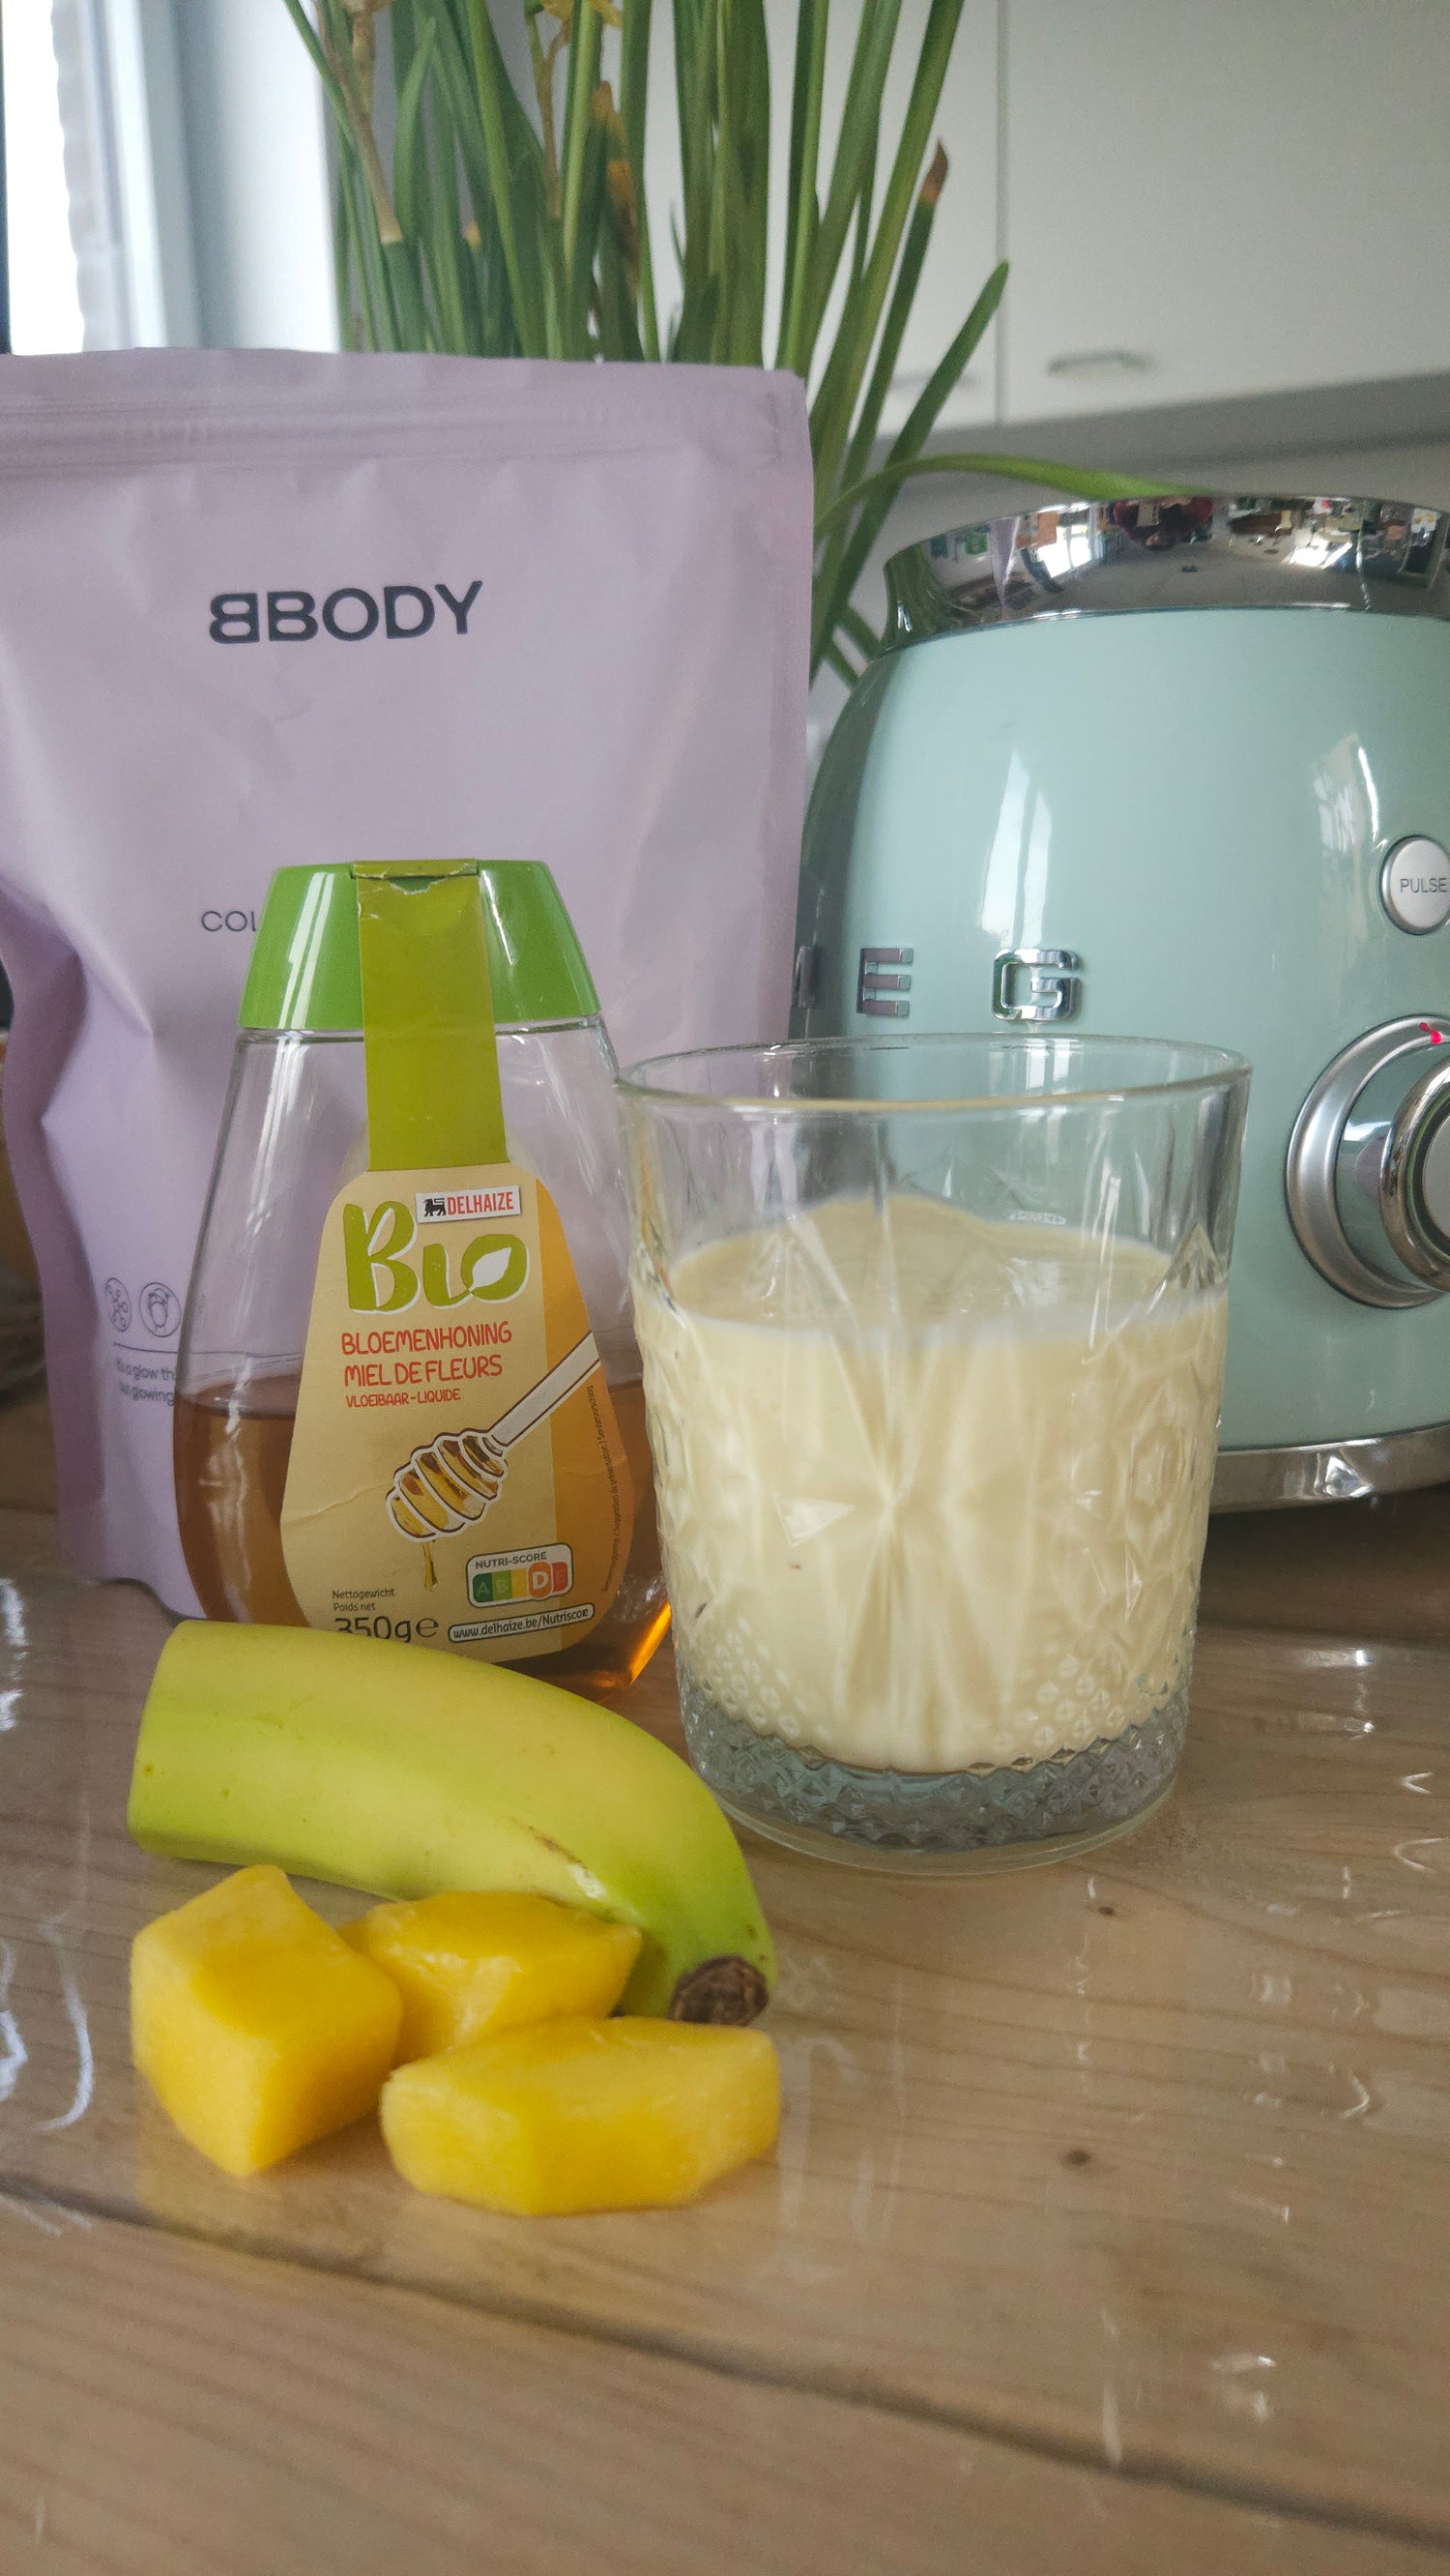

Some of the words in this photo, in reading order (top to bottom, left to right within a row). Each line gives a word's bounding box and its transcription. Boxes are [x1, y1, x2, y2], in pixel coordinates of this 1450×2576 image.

[1399, 877, 1448, 893] PULSE
[447, 1191, 514, 1216] DELHAIZE
[341, 1321, 512, 1356] BLOEMENHONING
[344, 1361, 391, 1387] MIEL
[394, 1361, 422, 1385] DE
[425, 1354, 503, 1383] FLEURS
[475, 1551, 547, 1569] NUTRI-SCORE
[532, 1570, 549, 1590] D
[332, 1588, 395, 1600] Nettogewicht
[334, 1602, 359, 1612] Poids
[361, 1602, 376, 1611] net
